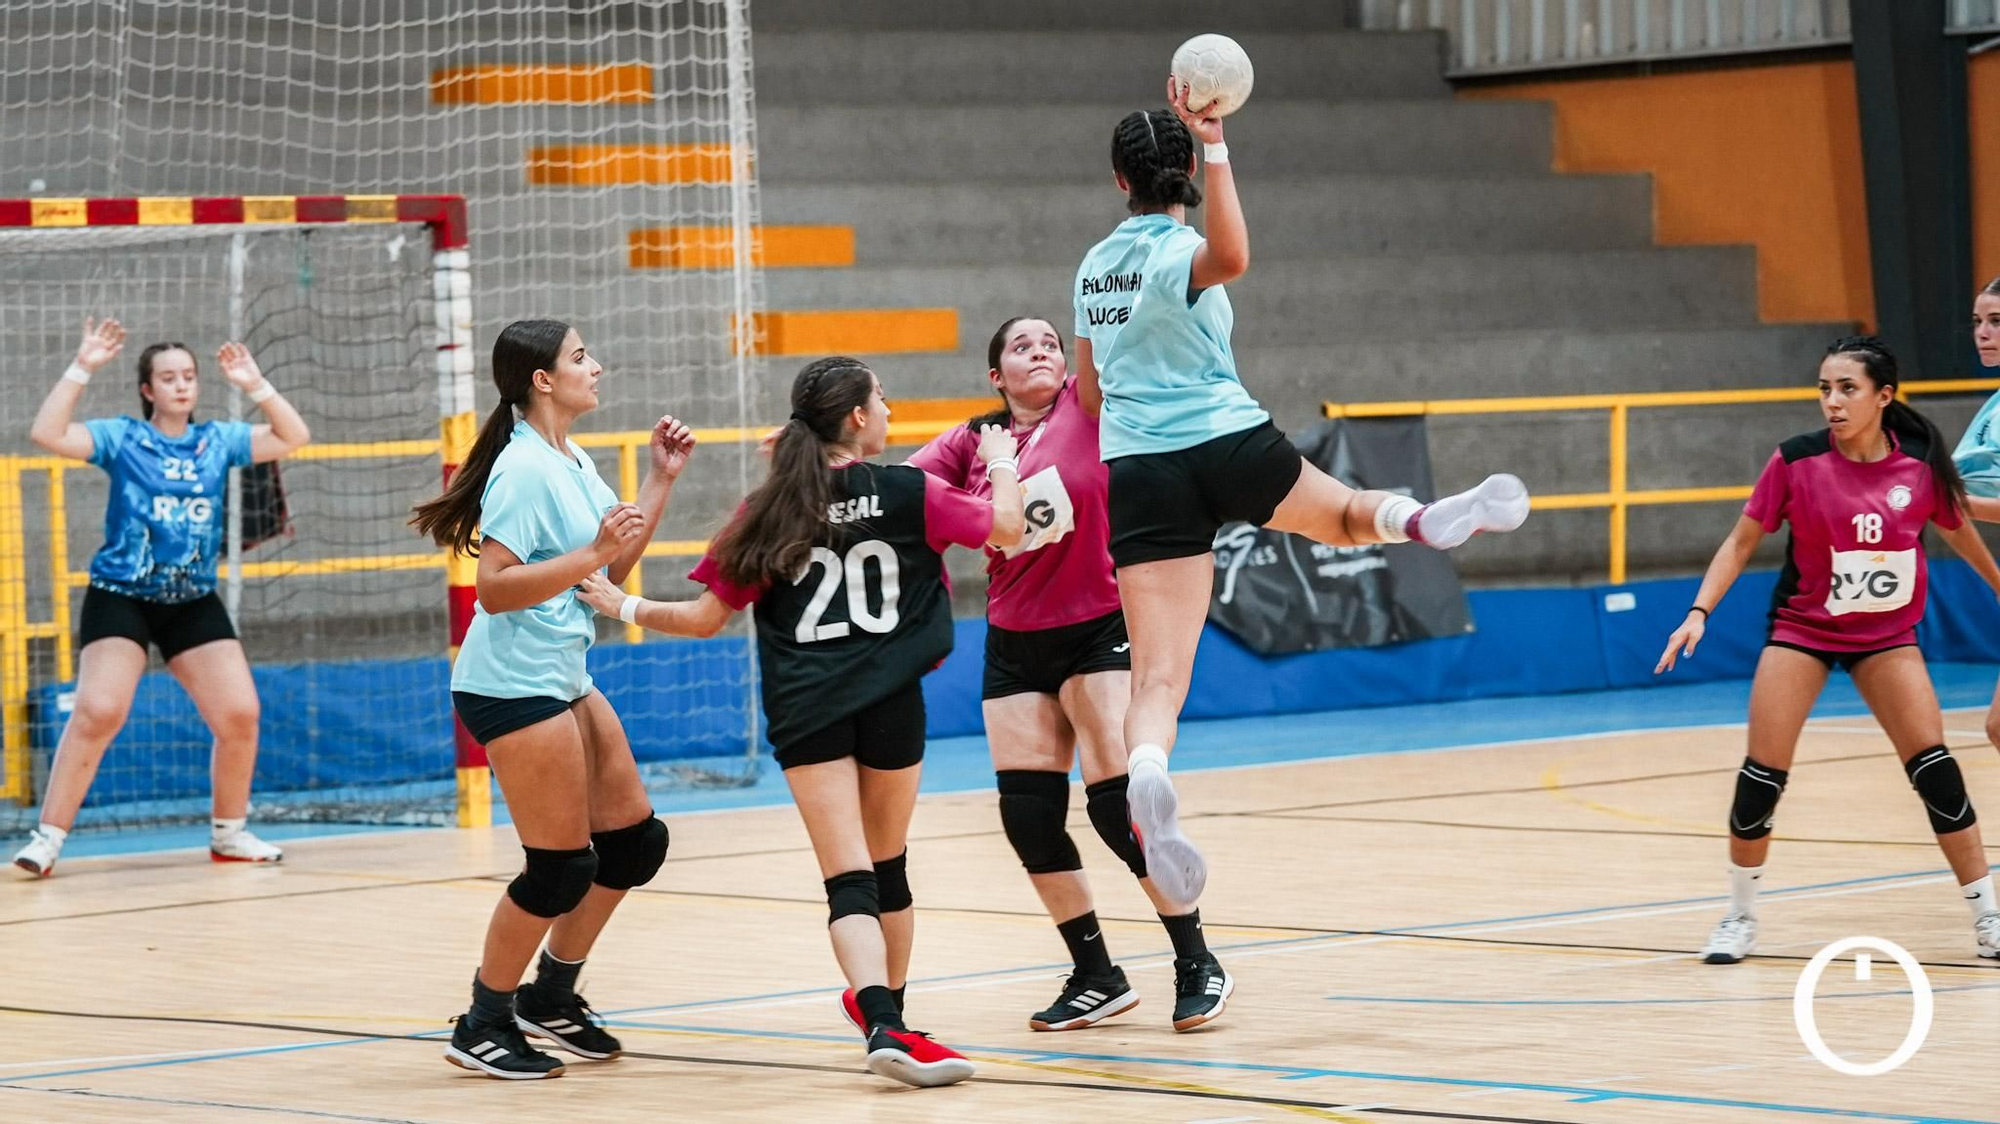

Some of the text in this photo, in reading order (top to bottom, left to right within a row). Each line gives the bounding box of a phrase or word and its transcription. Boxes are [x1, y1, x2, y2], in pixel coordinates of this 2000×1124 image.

[1087, 306, 1132, 326] LUCE
[827, 494, 884, 524] ESAL
[1851, 512, 1883, 544] 18
[792, 539, 900, 643] 20
[1830, 569, 1899, 601] RVG
